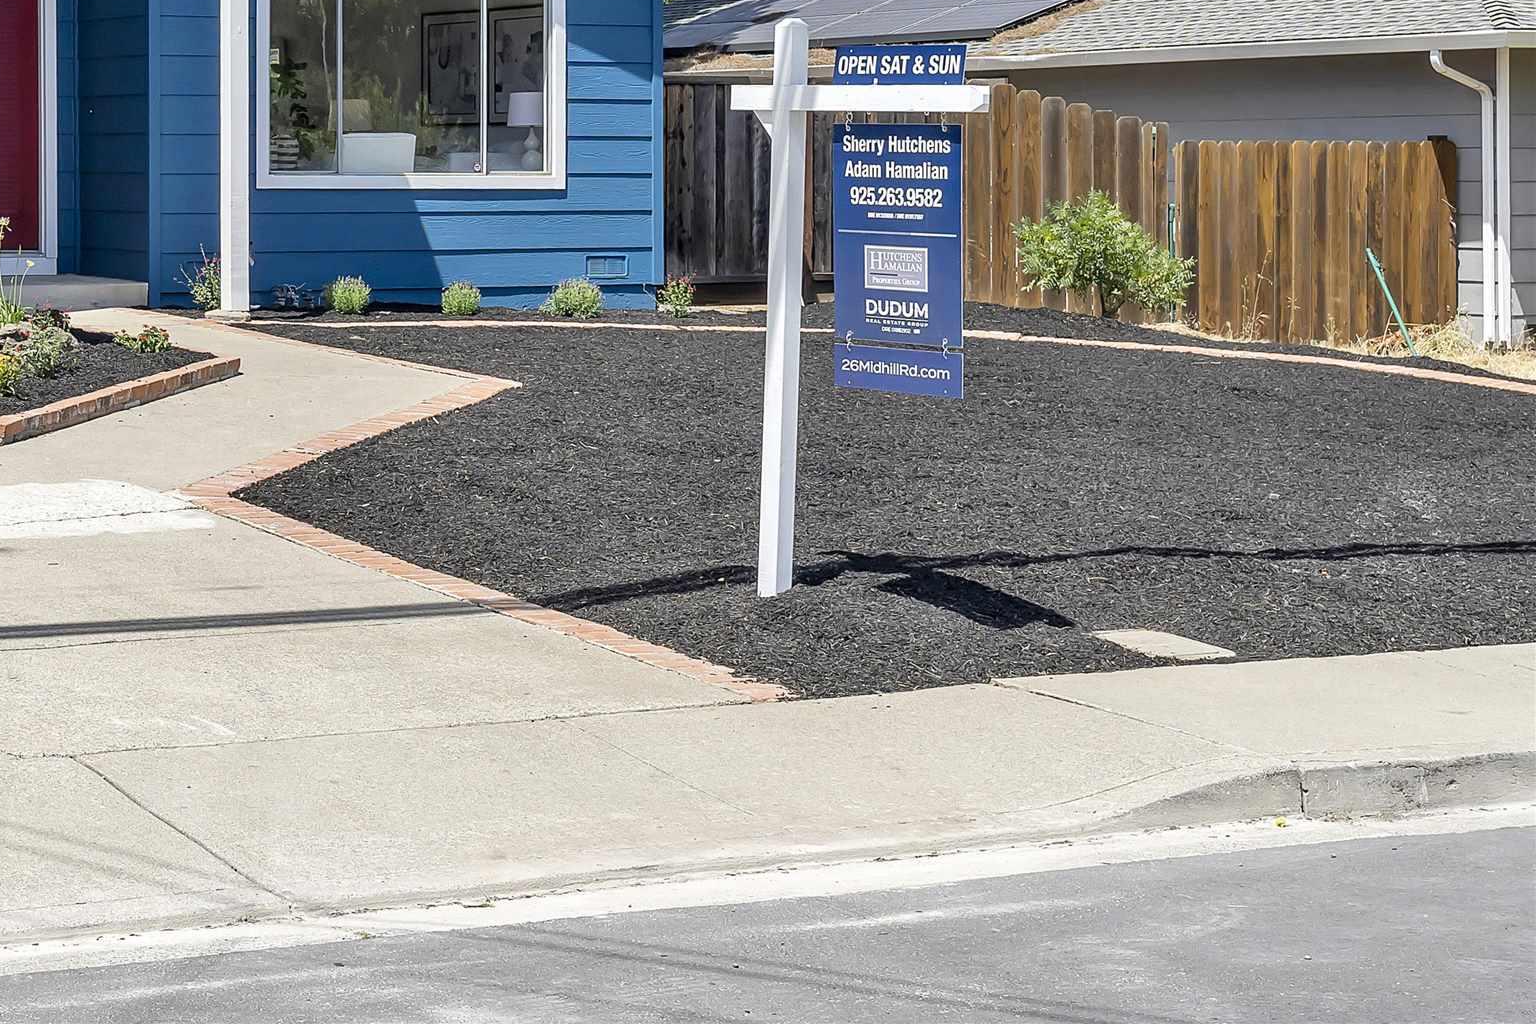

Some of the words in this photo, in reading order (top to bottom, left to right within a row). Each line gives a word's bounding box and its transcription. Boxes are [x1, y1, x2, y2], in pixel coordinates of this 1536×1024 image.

[838, 55, 877, 75] OPEN
[880, 55, 910, 75] SAT
[912, 56, 925, 75] &
[928, 55, 961, 75] SUN
[843, 135, 884, 156] Sherry
[888, 135, 951, 154] Hutchens
[845, 160, 881, 178] Adam
[885, 161, 948, 180] Hamalian
[850, 186, 943, 208] 925.263.9582
[865, 299, 929, 319] DUDUM
[841, 359, 951, 380] 26MidhillRd.com
